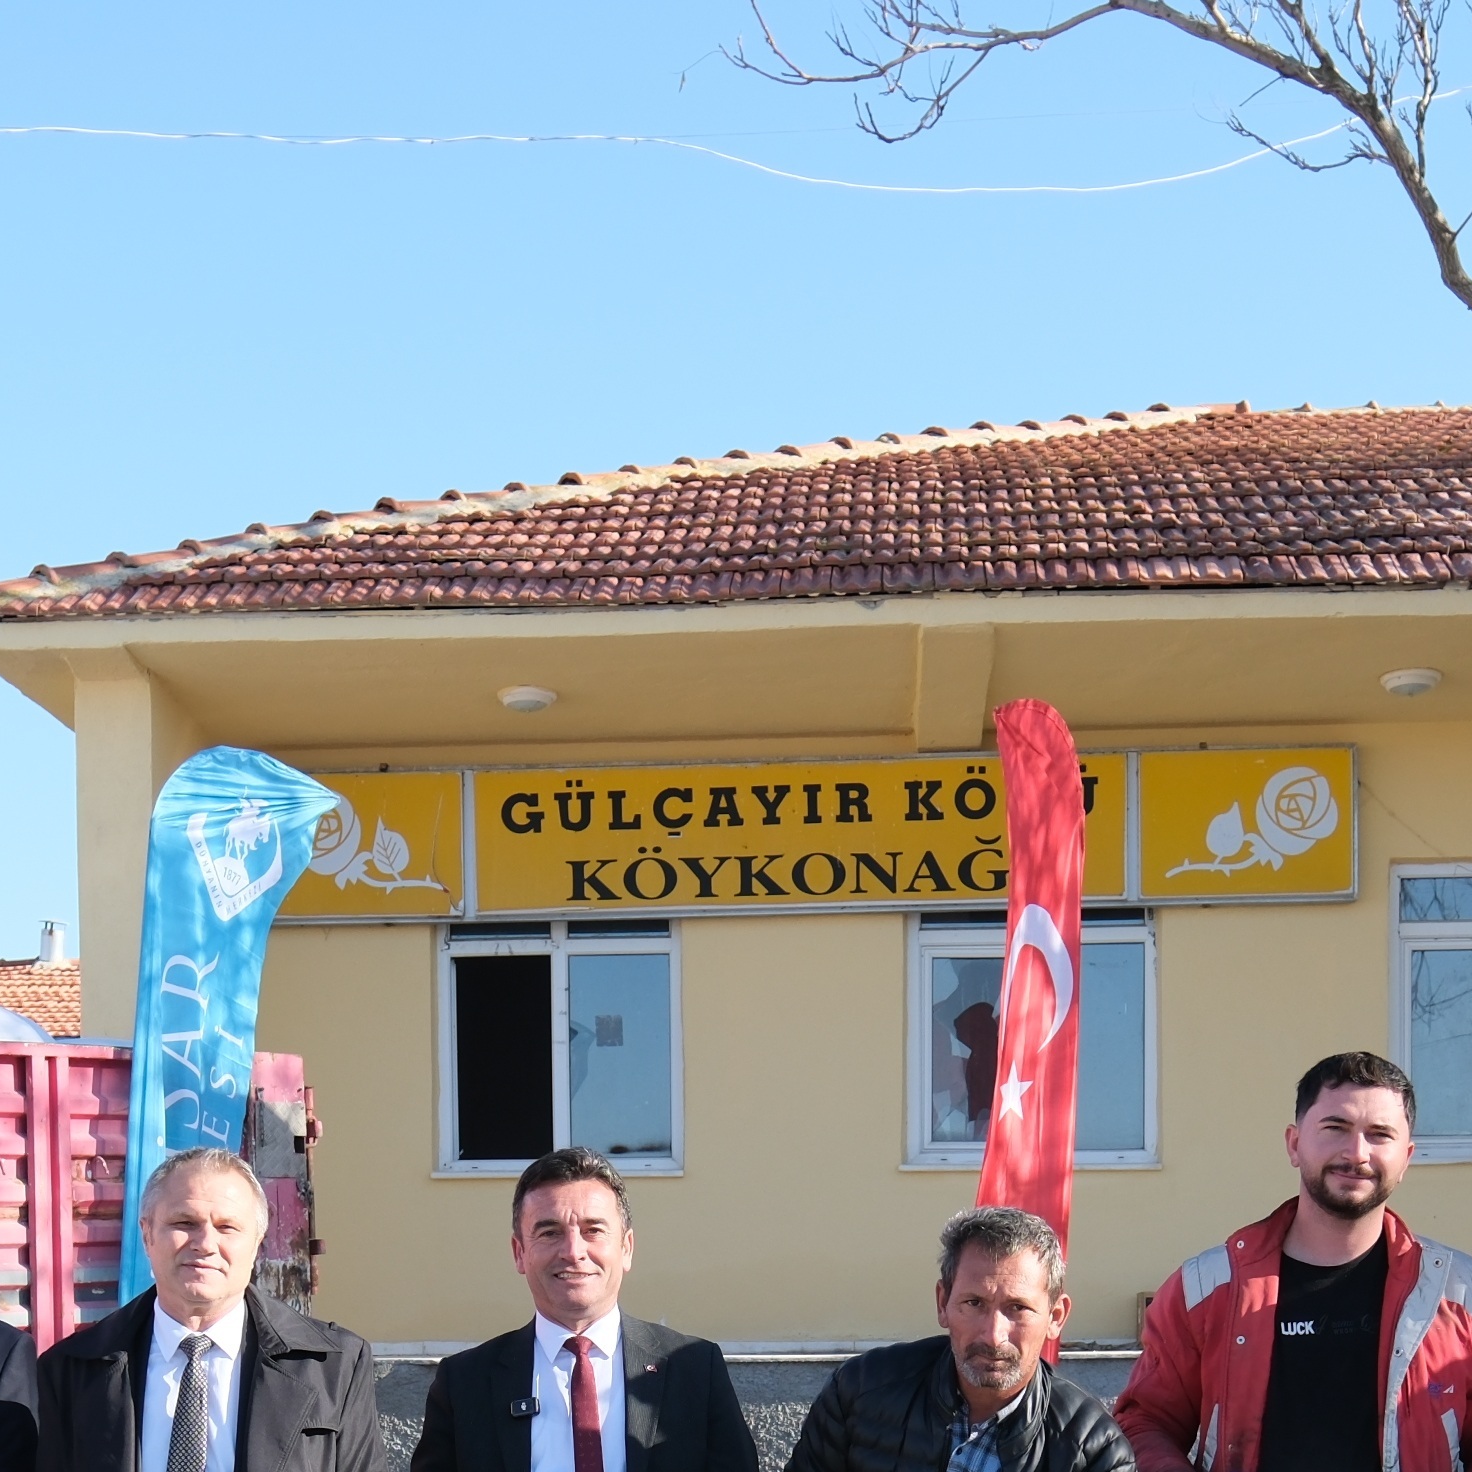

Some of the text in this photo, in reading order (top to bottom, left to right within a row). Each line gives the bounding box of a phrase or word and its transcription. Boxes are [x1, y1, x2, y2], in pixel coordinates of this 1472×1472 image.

[500, 764, 1099, 838] GÜLÇAYIR KÖ
[223, 867, 241, 886] 1877
[566, 834, 1010, 901] KÖYKONAĞ
[1280, 1320, 1315, 1336] LUCK
